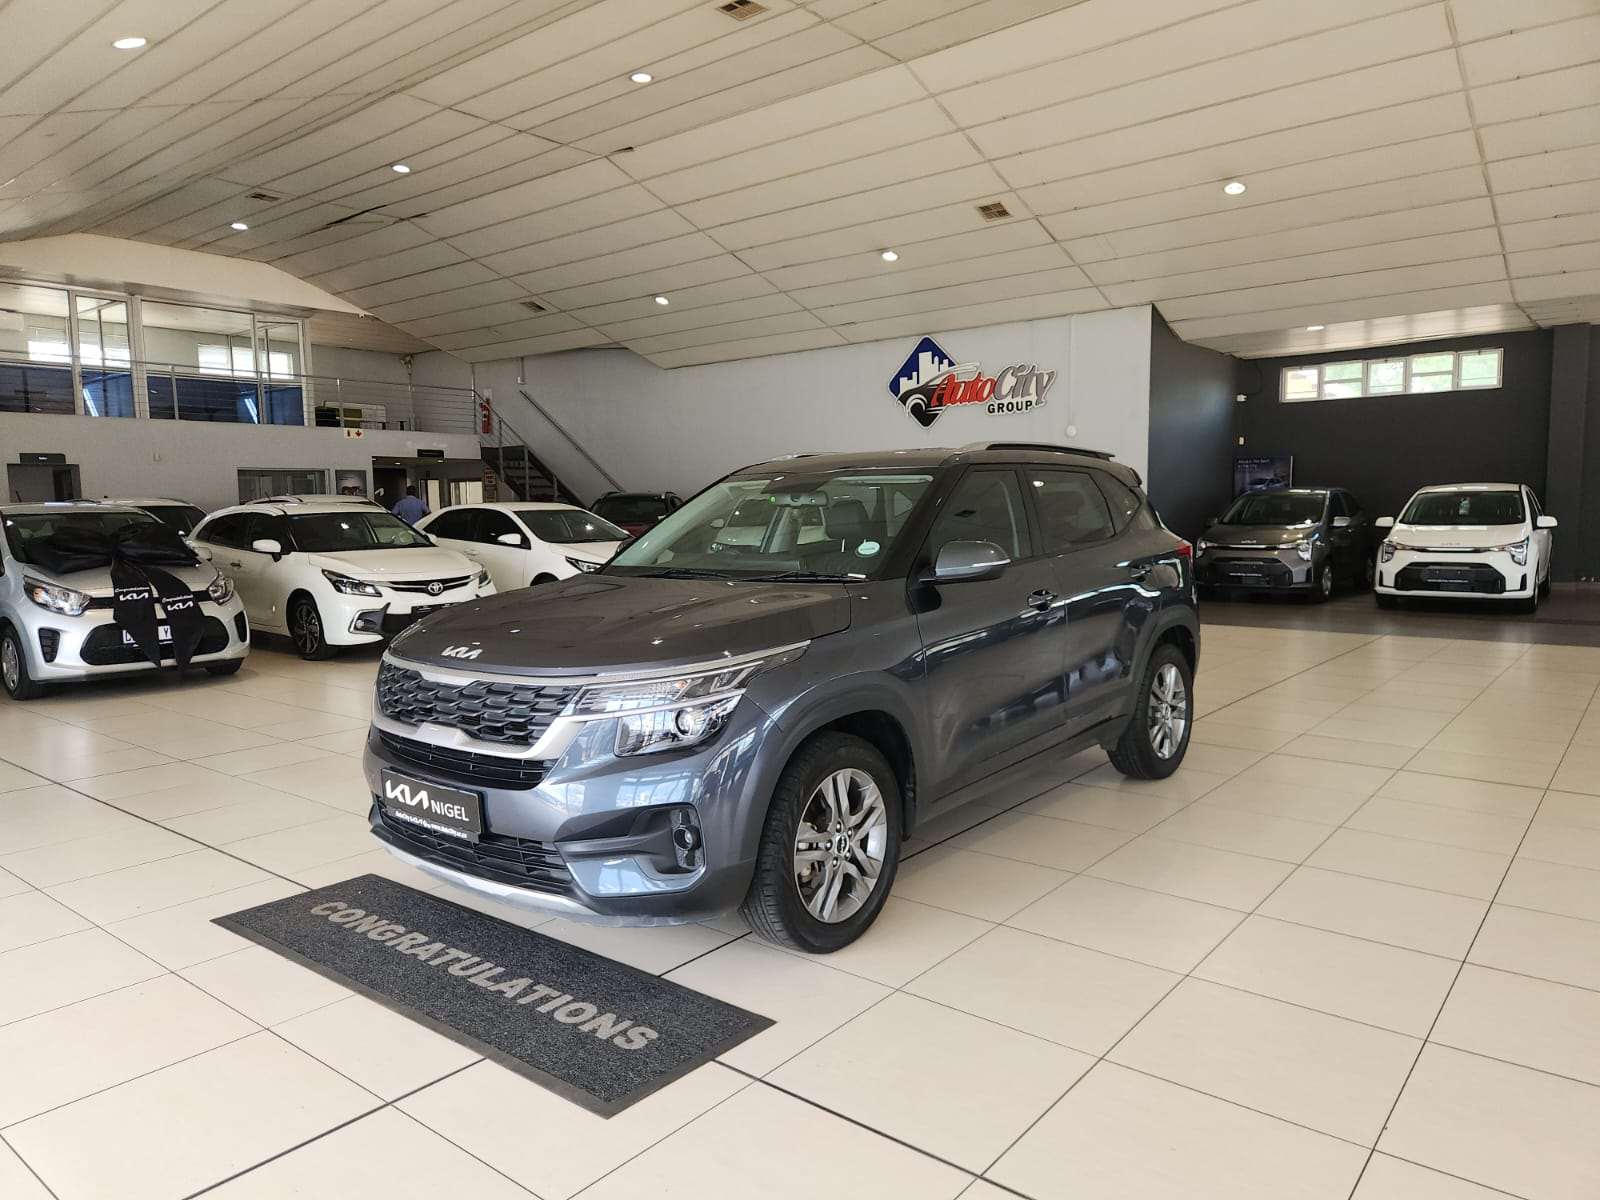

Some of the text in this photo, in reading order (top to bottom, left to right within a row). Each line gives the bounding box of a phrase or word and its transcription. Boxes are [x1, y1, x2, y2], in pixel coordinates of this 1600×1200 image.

[987, 399, 1033, 414] GROUP
[119, 592, 149, 601] KIA
[167, 601, 194, 611] KIA
[440, 646, 483, 660] KIA
[385, 780, 470, 822] KIA NIGEL
[310, 901, 659, 1051] CONGRATULATIONS
